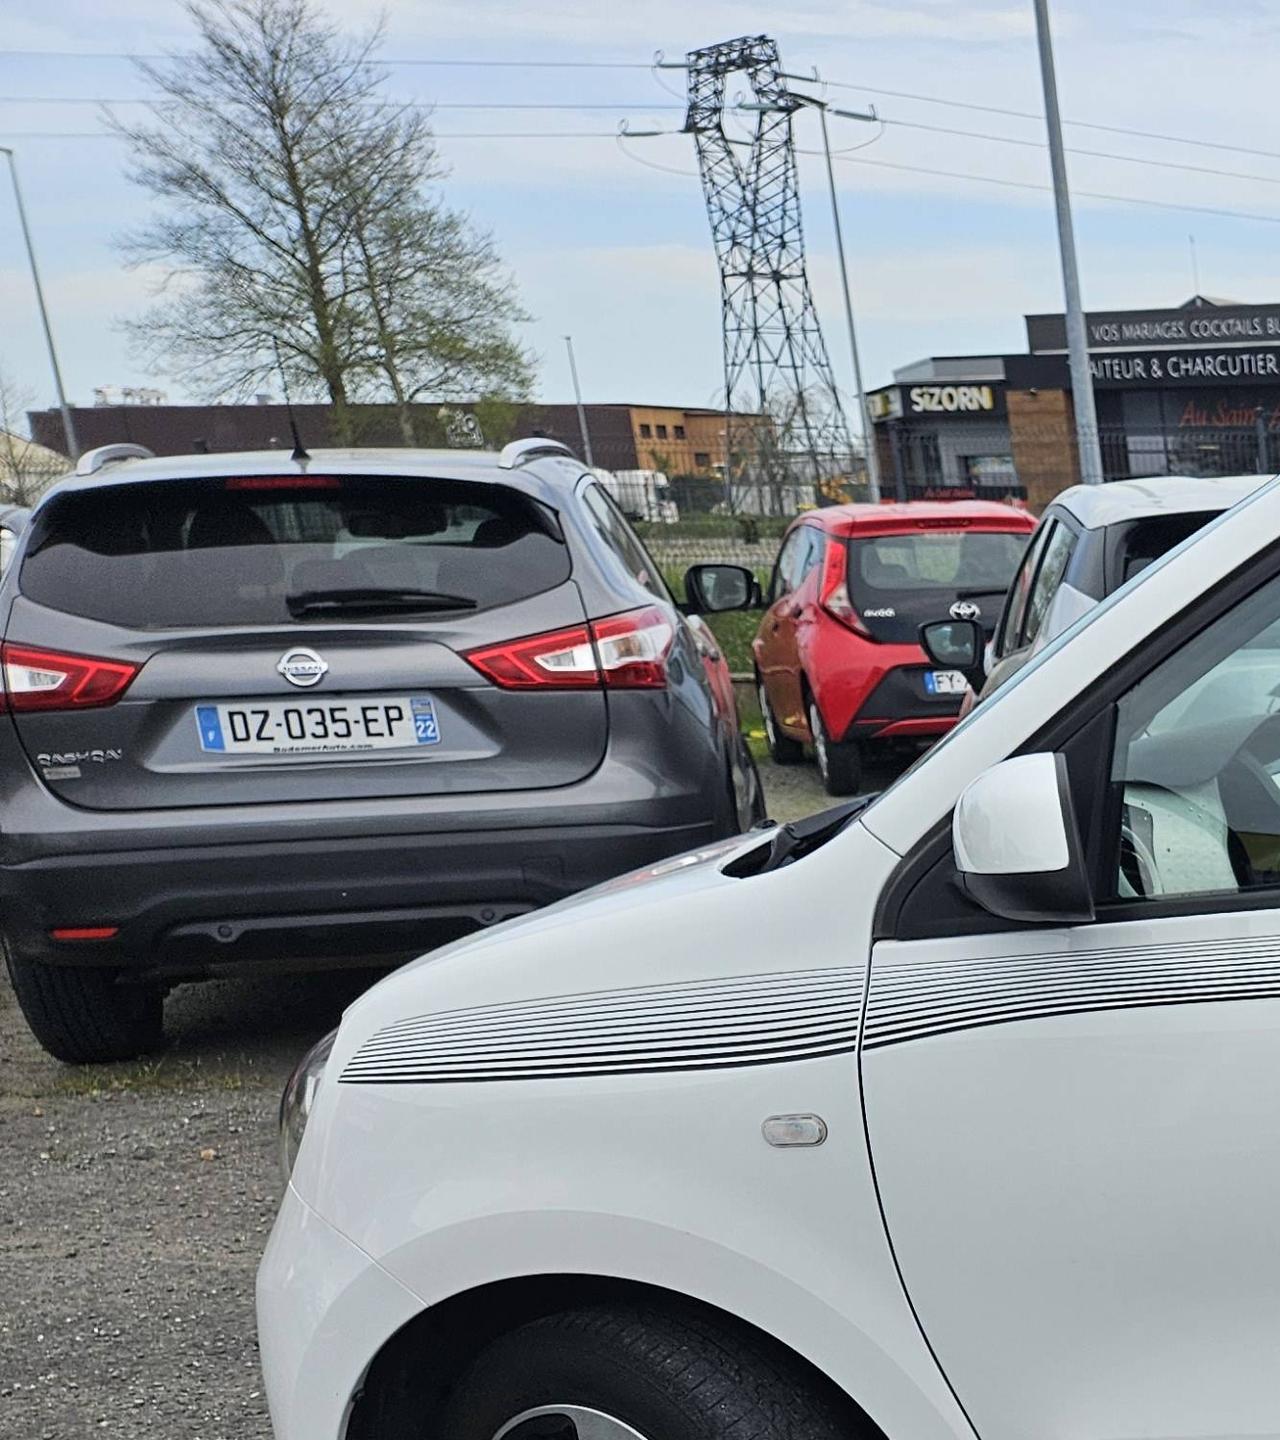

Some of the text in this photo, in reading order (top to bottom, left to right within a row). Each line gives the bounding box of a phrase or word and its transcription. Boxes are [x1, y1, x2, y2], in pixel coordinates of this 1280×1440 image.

[1090, 323, 1120, 342] VOS
[1087, 357, 1148, 380] AITEUR
[1150, 357, 1163, 379] &
[1166, 352, 1280, 378] CHARCUTIER
[1213, 400, 1262, 427] Sain
[228, 705, 405, 743] DZ-035-EP
[415, 721, 437, 739] 22
